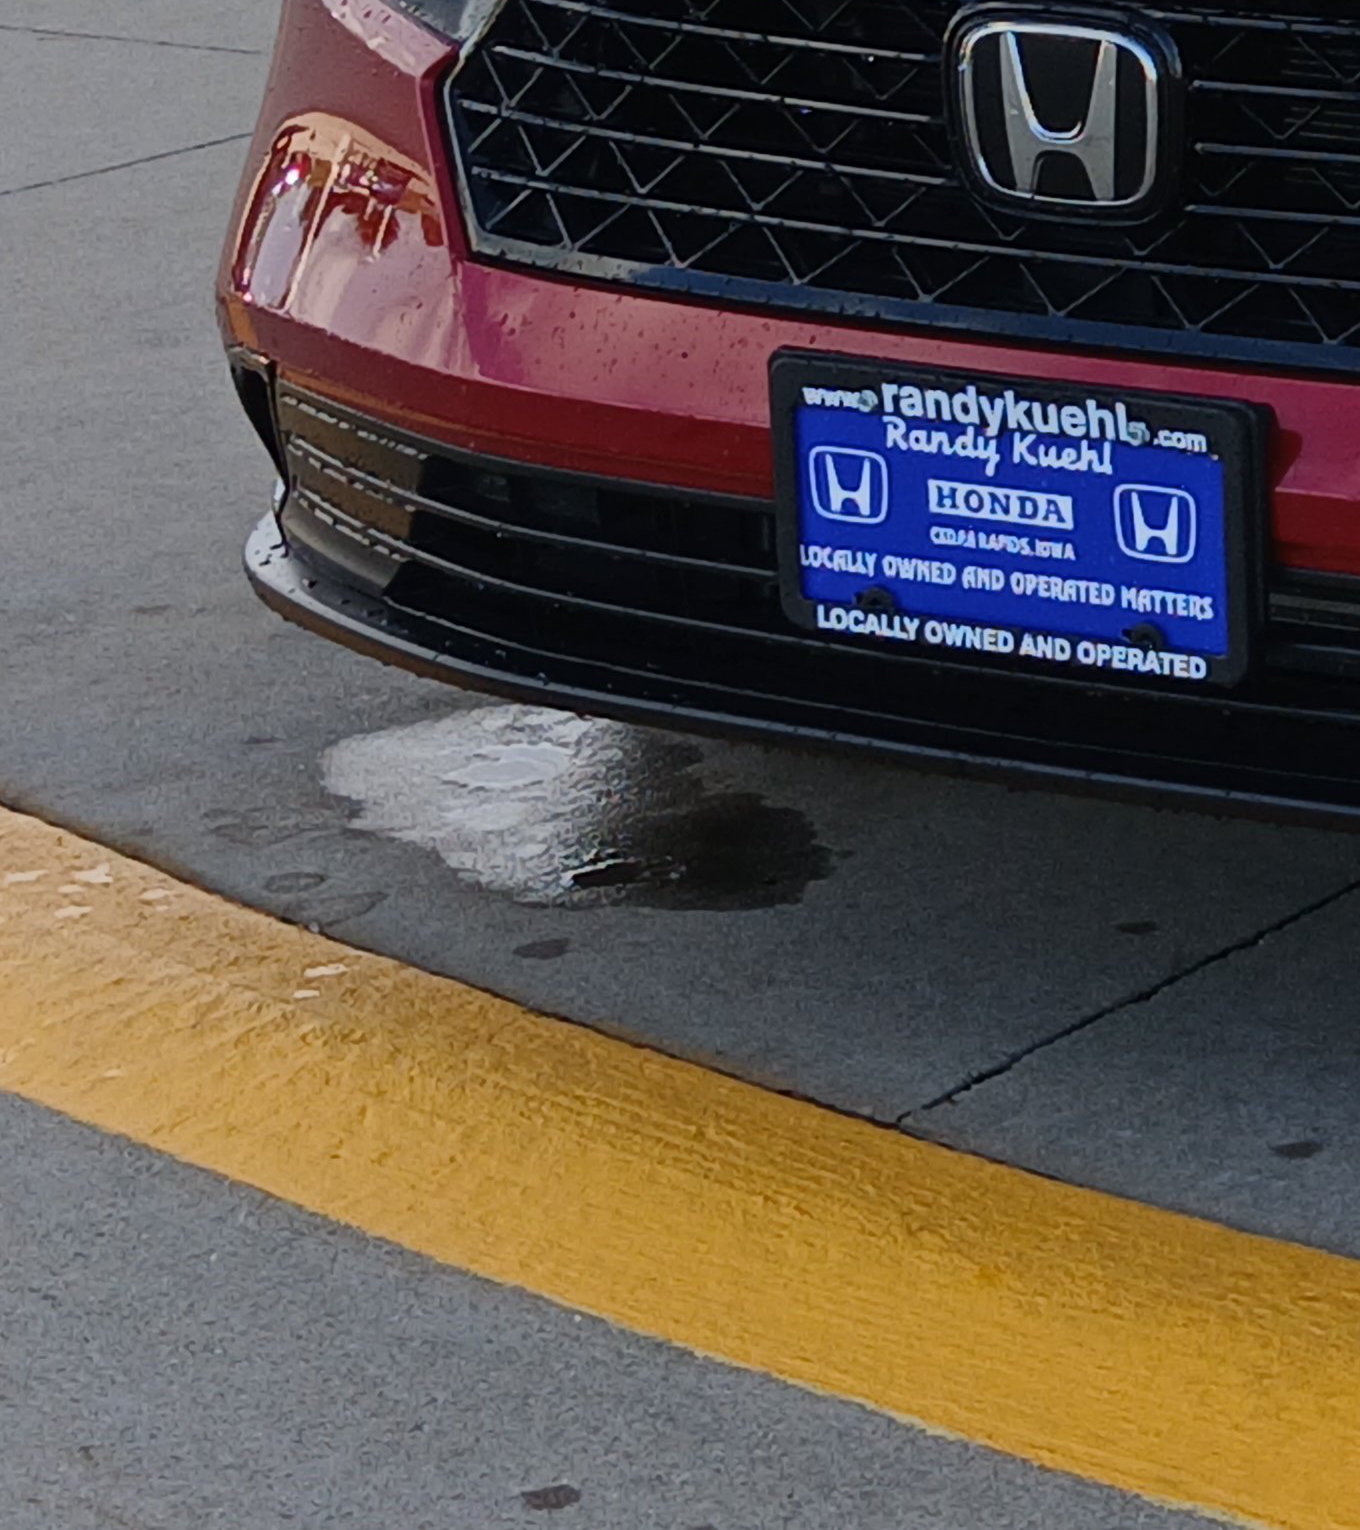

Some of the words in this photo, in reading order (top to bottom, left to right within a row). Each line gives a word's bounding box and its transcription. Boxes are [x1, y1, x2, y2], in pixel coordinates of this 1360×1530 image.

[883, 415, 999, 477] Randy
[1012, 431, 1113, 475] Kuehl
[936, 485, 1066, 523] HONDA
[800, 543, 877, 577] LOCALLY
[882, 555, 956, 585] OWNED
[962, 566, 1005, 590] AND
[1010, 571, 1115, 606] OPERATED
[1120, 585, 1214, 620] MATTERS
[817, 604, 920, 641] LOCALLY
[924, 620, 1015, 653] OWNED
[1018, 632, 1072, 661] AND
[1076, 640, 1207, 680] OPERATED
